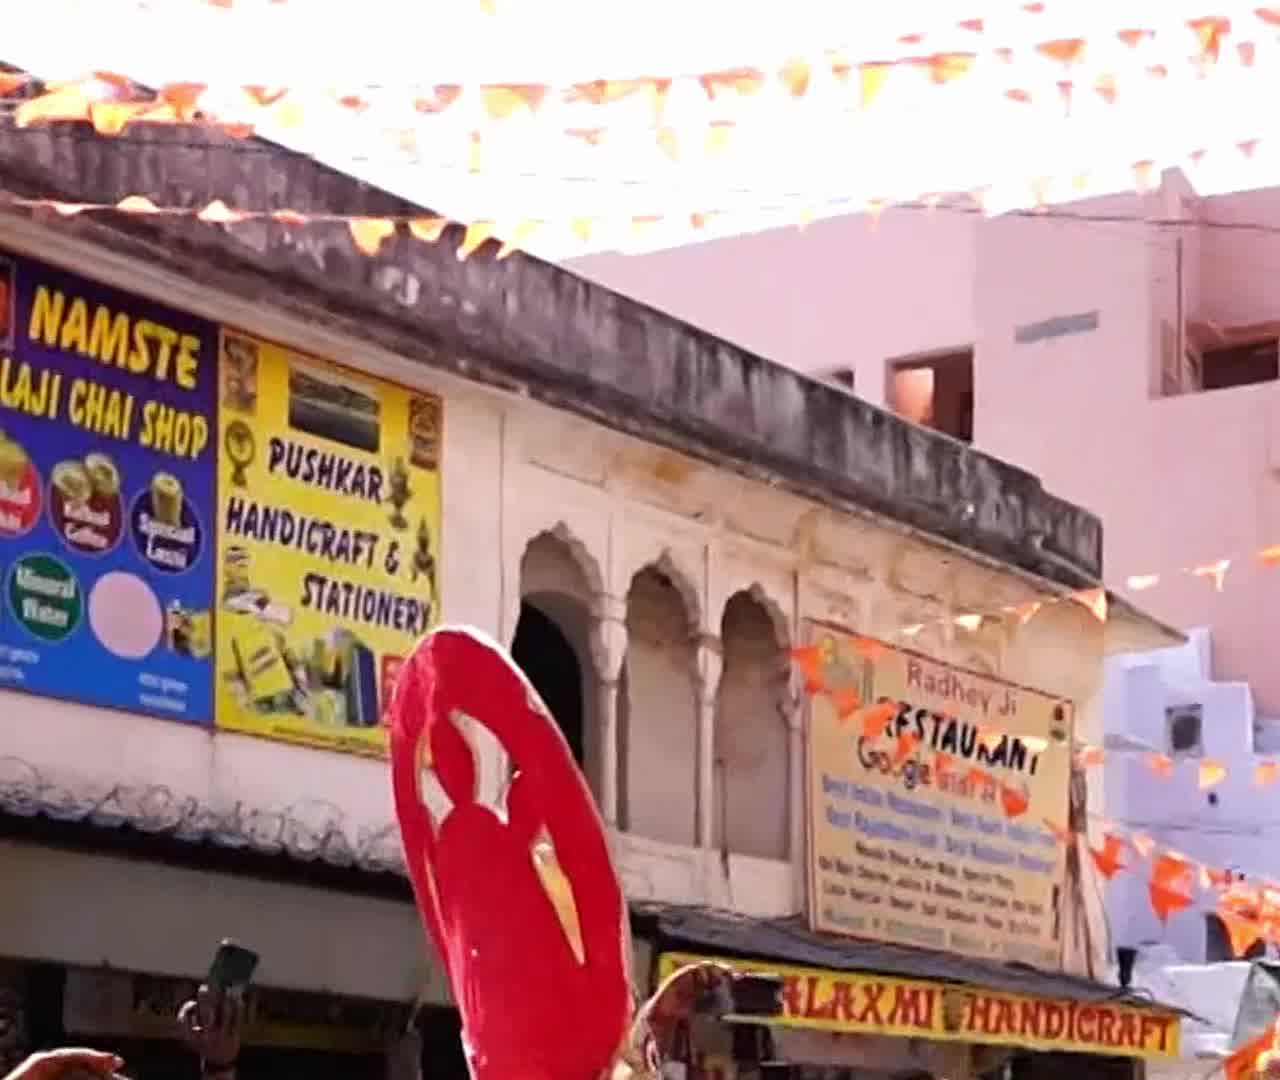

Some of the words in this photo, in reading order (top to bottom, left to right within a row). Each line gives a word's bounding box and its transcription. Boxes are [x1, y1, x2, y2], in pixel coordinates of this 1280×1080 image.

[27, 285, 202, 391] NAMSTE
[69, 372, 131, 440] CHAI
[138, 402, 209, 461] SHOP
[268, 434, 387, 503] PUSHKAR
[224, 496, 380, 566] HANDICRAFT
[383, 540, 400, 575] &
[298, 571, 434, 637] STATIONERY
[906, 658, 993, 717] Radhey
[998, 687, 1018, 717] Ji
[778, 974, 938, 1030] ALAXMI
[965, 996, 1173, 1053] HANDICRAFT
